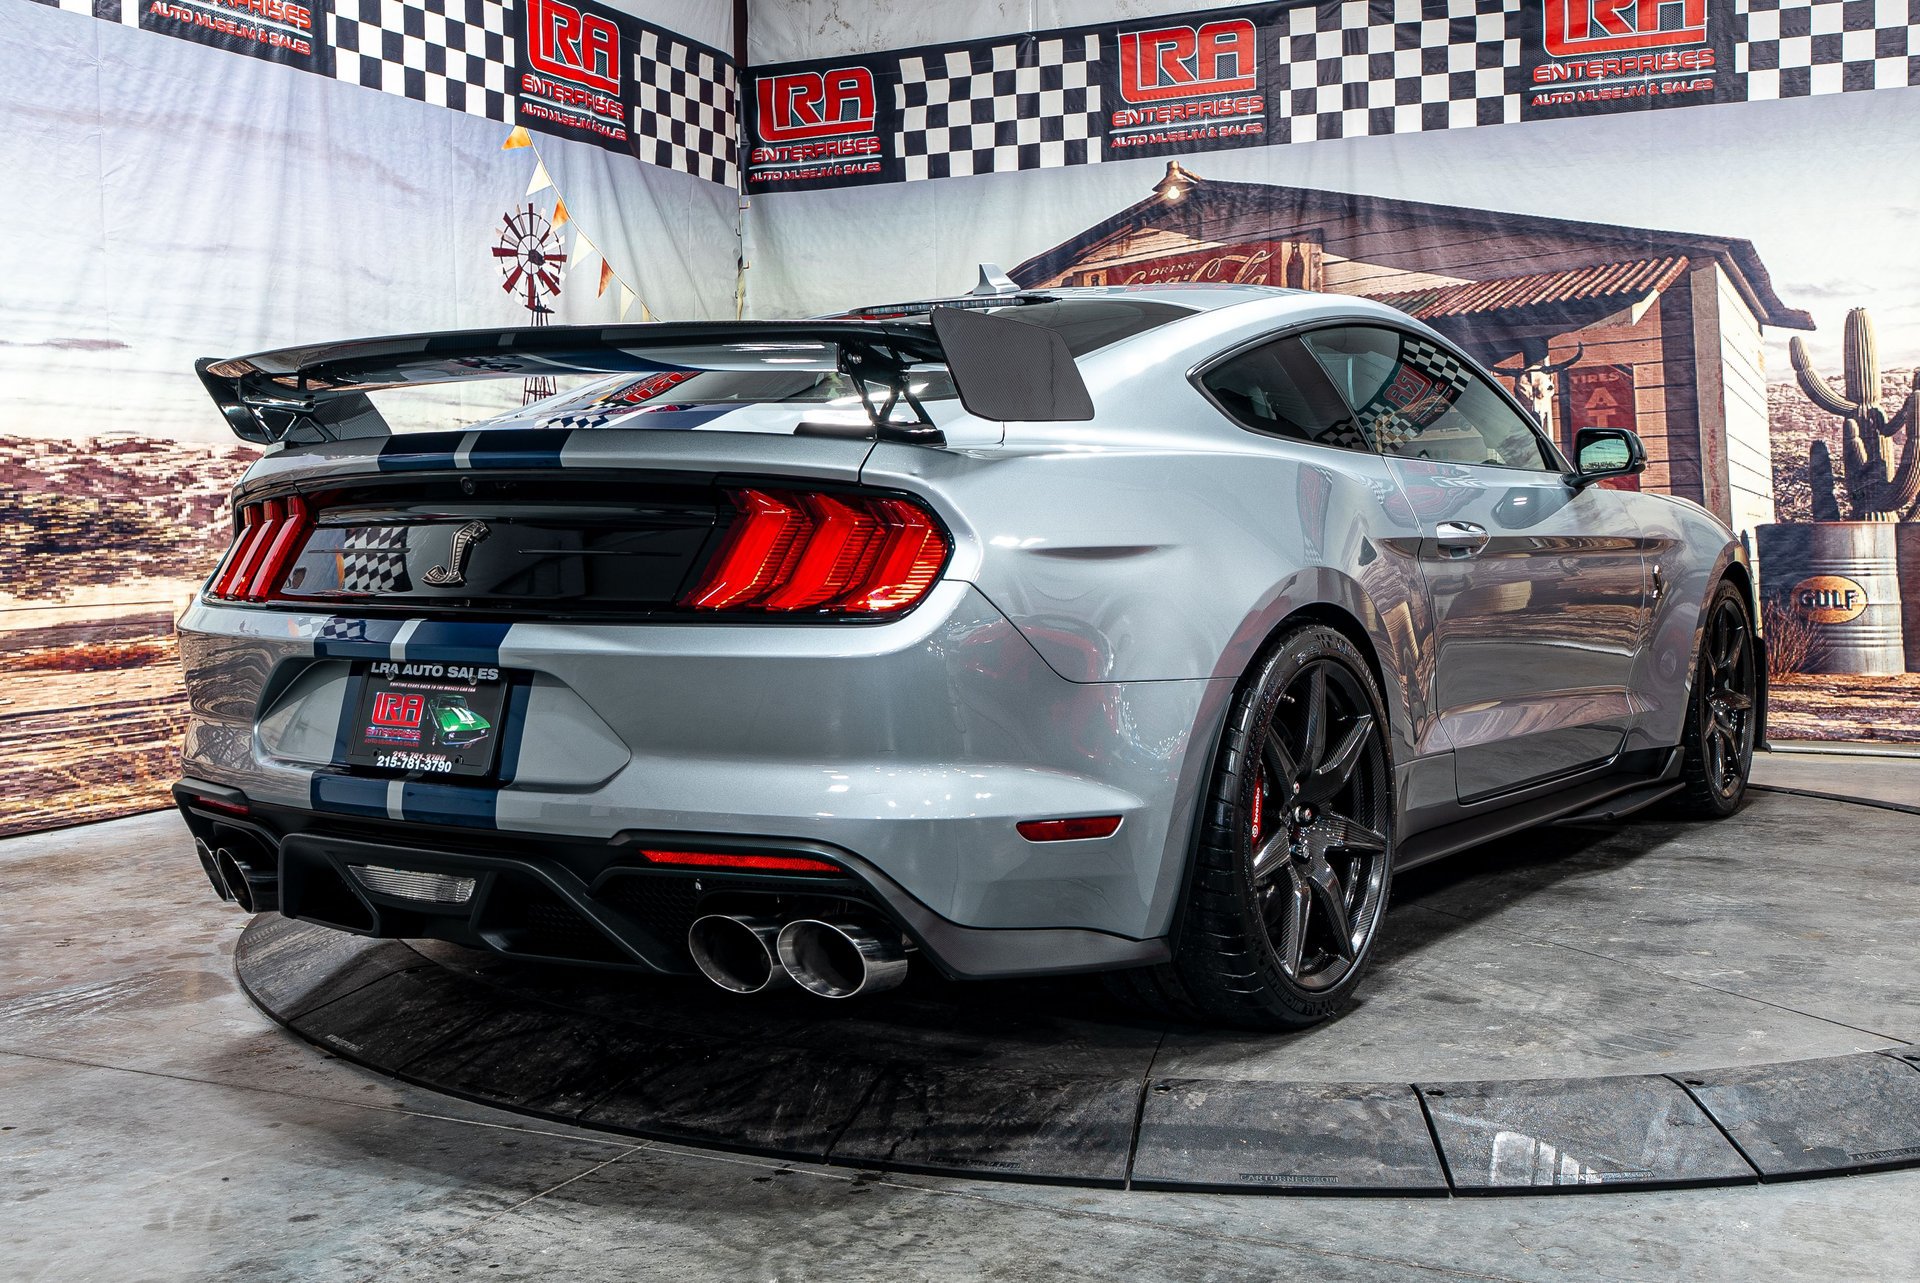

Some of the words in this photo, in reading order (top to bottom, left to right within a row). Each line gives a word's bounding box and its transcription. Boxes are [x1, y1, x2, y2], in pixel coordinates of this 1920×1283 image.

[150, 1, 193, 23] AUTO
[194, 13, 257, 41] MUSEUM
[257, 29, 269, 44] &
[268, 31, 312, 56] SALES
[526, 0, 620, 97] LRA
[1117, 18, 1257, 104] LRA
[1533, 48, 1716, 84] ENTERPRISES
[521, 73, 625, 120] ENTERPRISES
[756, 66, 877, 143] LRA
[1531, 92, 1576, 106] AUTO
[1577, 84, 1646, 102] MUSEUM
[1647, 83, 1660, 96] &
[1662, 78, 1714, 95] SALES
[521, 102, 549, 119] AUTO
[548, 109, 592, 130] MUSEUM
[597, 123, 628, 141] SALES
[1112, 95, 1265, 127] ENTERPRISES
[751, 136, 881, 164] ENTERPRISES
[1111, 135, 1148, 149] AUTO
[1150, 128, 1207, 144] MUSEUM
[1208, 126, 1217, 138] &
[1219, 123, 1264, 137] SALES
[750, 170, 783, 183] AUTO
[783, 165, 833, 180] MUSEUM
[833, 164, 843, 176] &
[843, 162, 882, 174] SALES
[1150, 261, 1197, 276] DRINK
[1570, 371, 1620, 384] TIRES
[1799, 589, 1859, 611] GULF
[371, 662, 399, 675] LRA
[402, 664, 444, 677] AUTO
[447, 666, 499, 680] SALES
[372, 692, 425, 728] LRA
[376, 755, 452, 772] 215-781-3790
[1253, 787, 1261, 823] brembo
[1240, 1174, 1339, 1184] CARTURNER.COM
